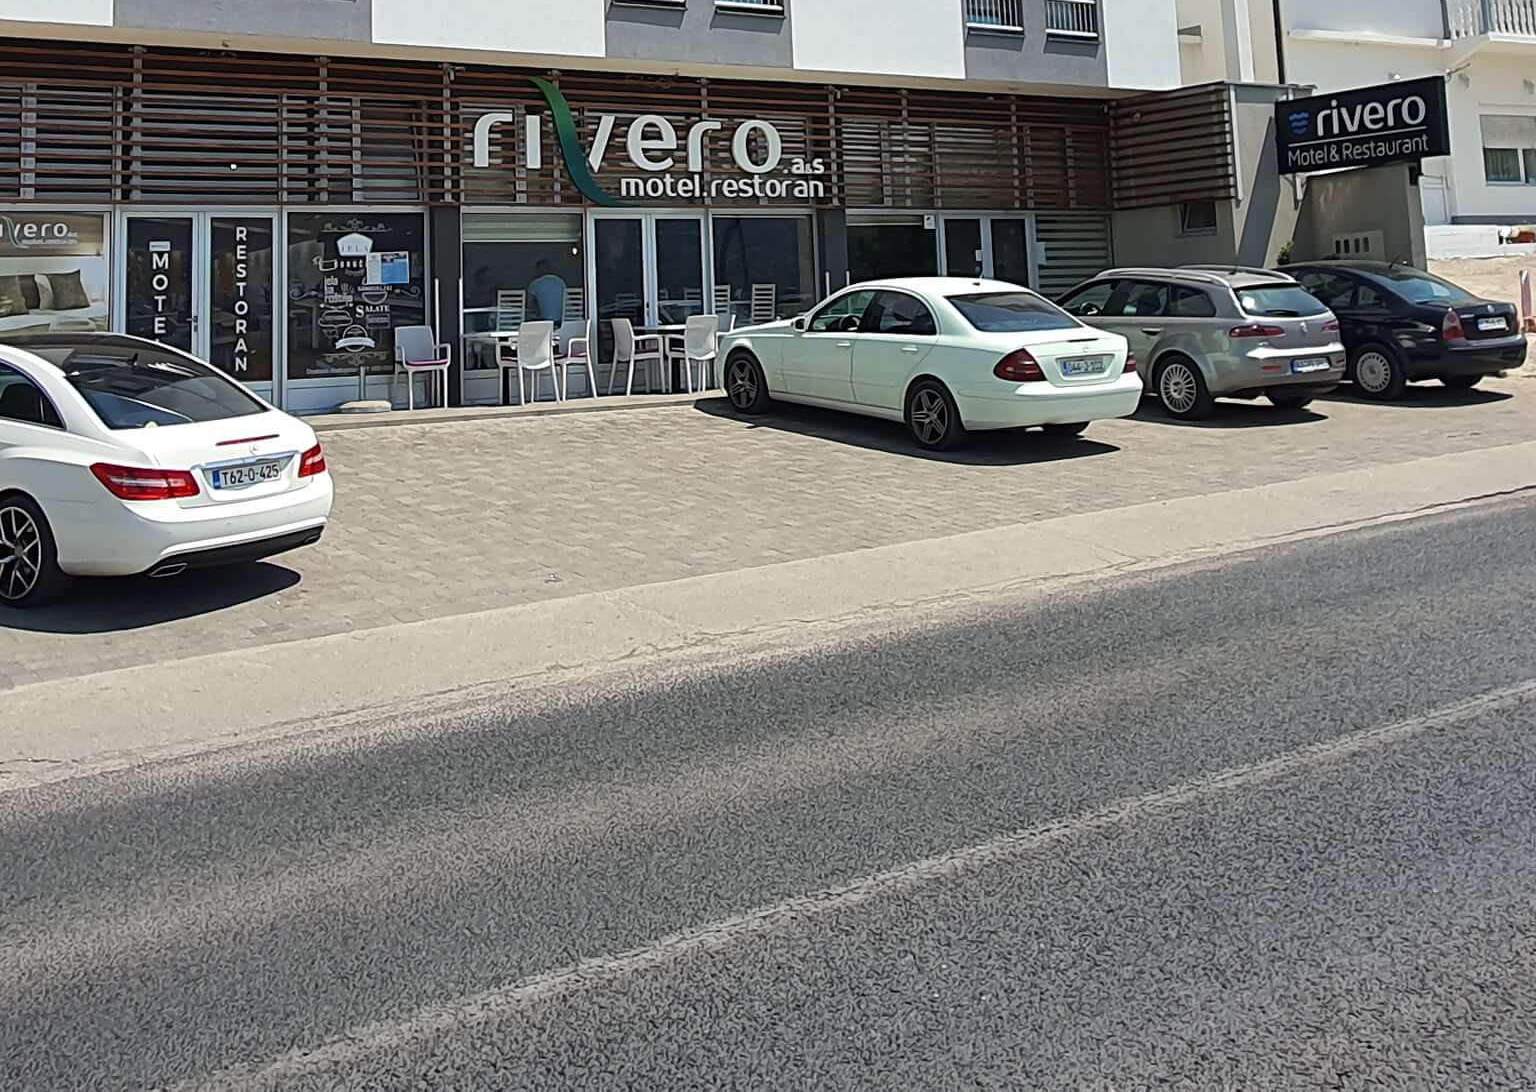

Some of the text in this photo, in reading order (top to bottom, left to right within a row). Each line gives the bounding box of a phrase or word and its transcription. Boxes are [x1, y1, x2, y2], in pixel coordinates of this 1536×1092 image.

[472, 88, 784, 188] rivero
[1316, 95, 1427, 137] rivero
[1288, 133, 1430, 167] Motel & Restaurant
[152, 253, 169, 343] MOTE
[234, 226, 249, 372] RESTORAN
[355, 305, 390, 318] SALATE
